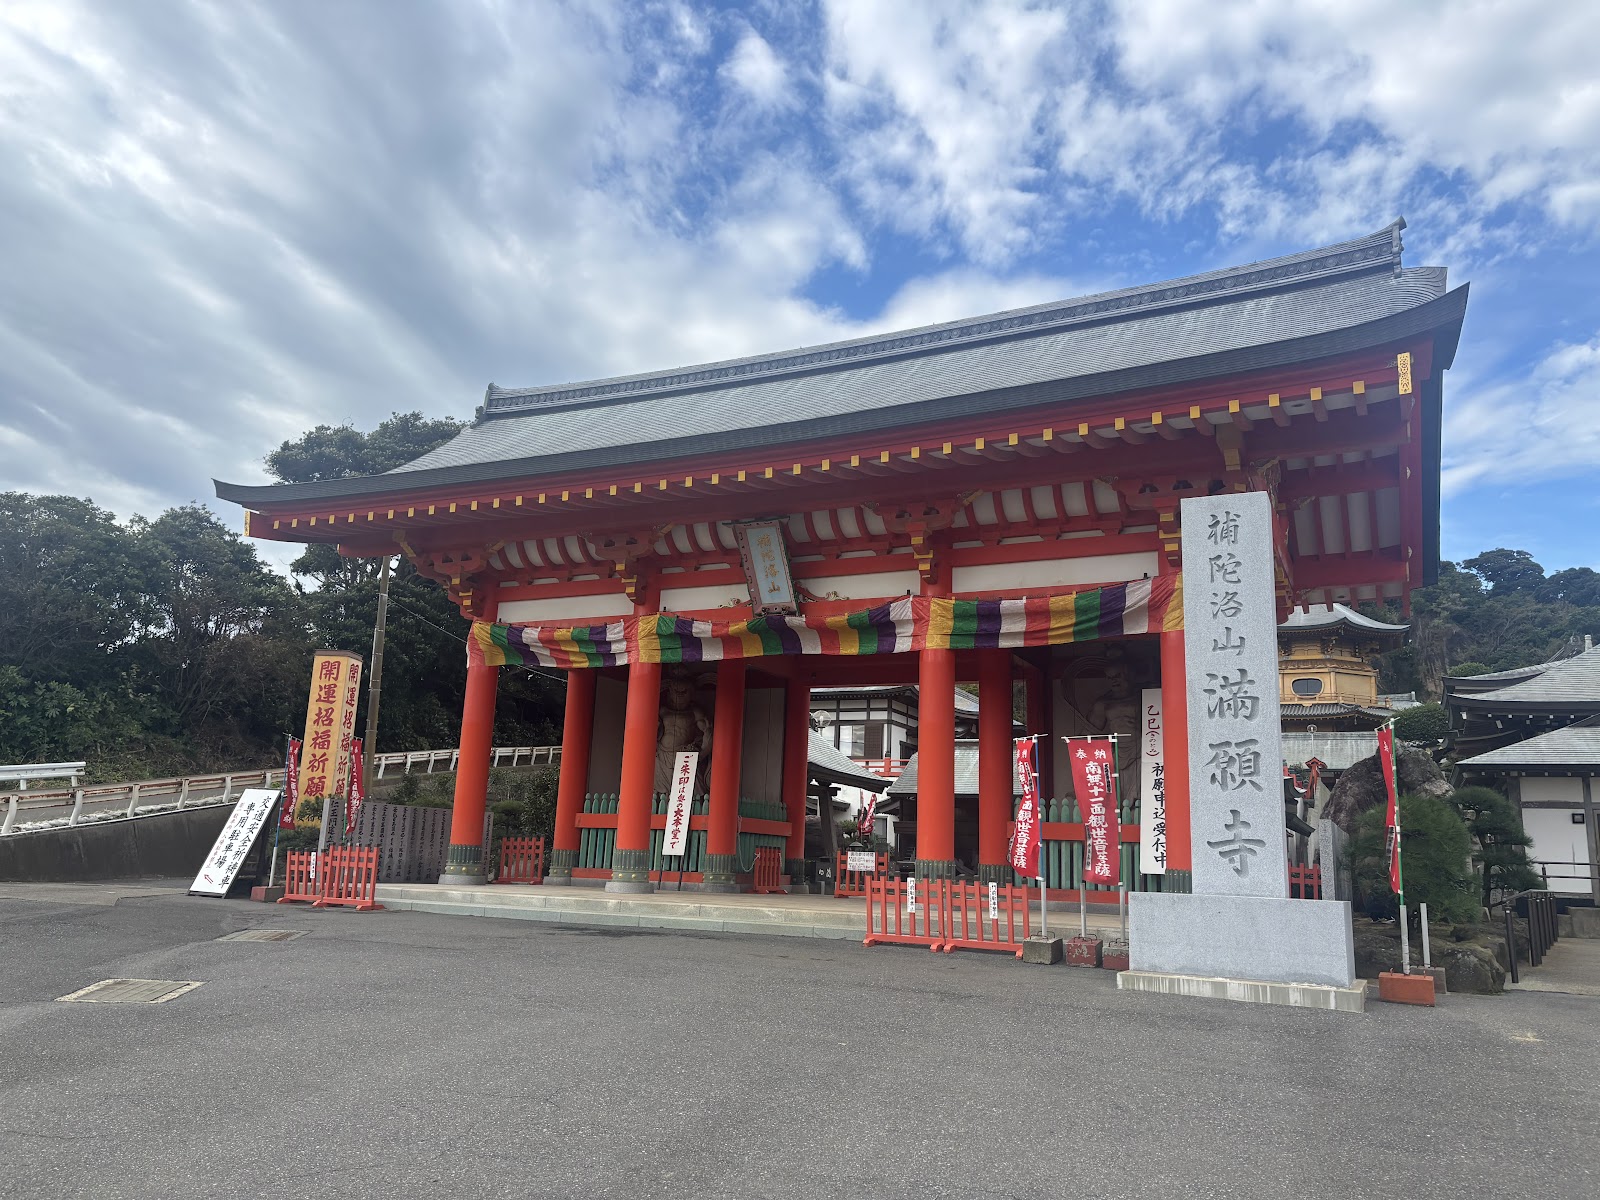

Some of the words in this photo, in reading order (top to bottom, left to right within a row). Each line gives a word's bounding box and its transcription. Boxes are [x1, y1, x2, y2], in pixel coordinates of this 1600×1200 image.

[303, 660, 341, 798] 開運招福祈願
[334, 663, 360, 798] 開運招福祈願
[1075, 748, 1107, 760] 奉納
[1085, 761, 1111, 877] 南無十一面観世音菩薩
